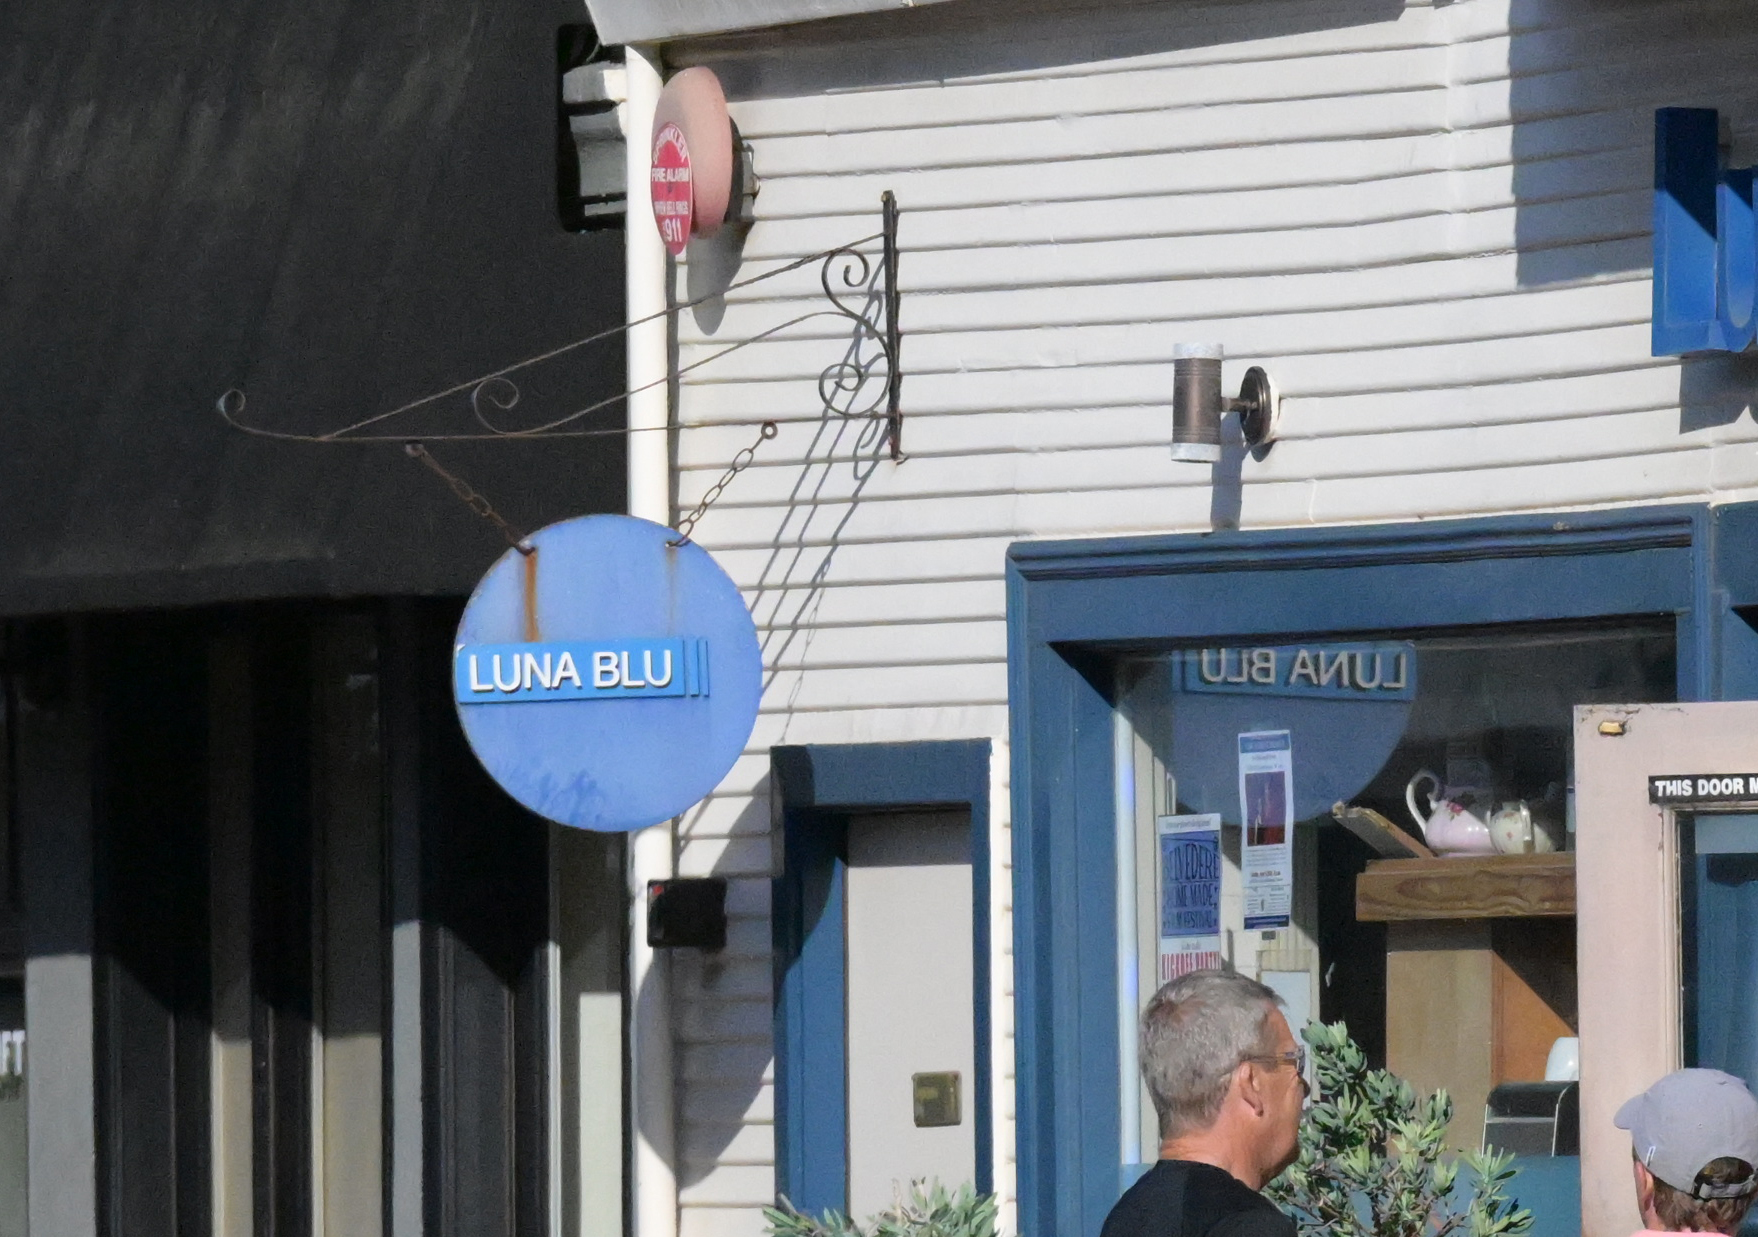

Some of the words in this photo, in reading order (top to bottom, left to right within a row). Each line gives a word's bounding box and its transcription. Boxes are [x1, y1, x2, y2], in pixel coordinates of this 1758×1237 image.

[652, 167, 666, 182] FIRE
[667, 167, 689, 182] ALARM
[665, 218, 682, 242] 911
[469, 651, 582, 693] LUNA
[592, 649, 672, 688] BLU
[1655, 780, 1693, 798] THIS
[1697, 778, 1744, 796] DOOR
